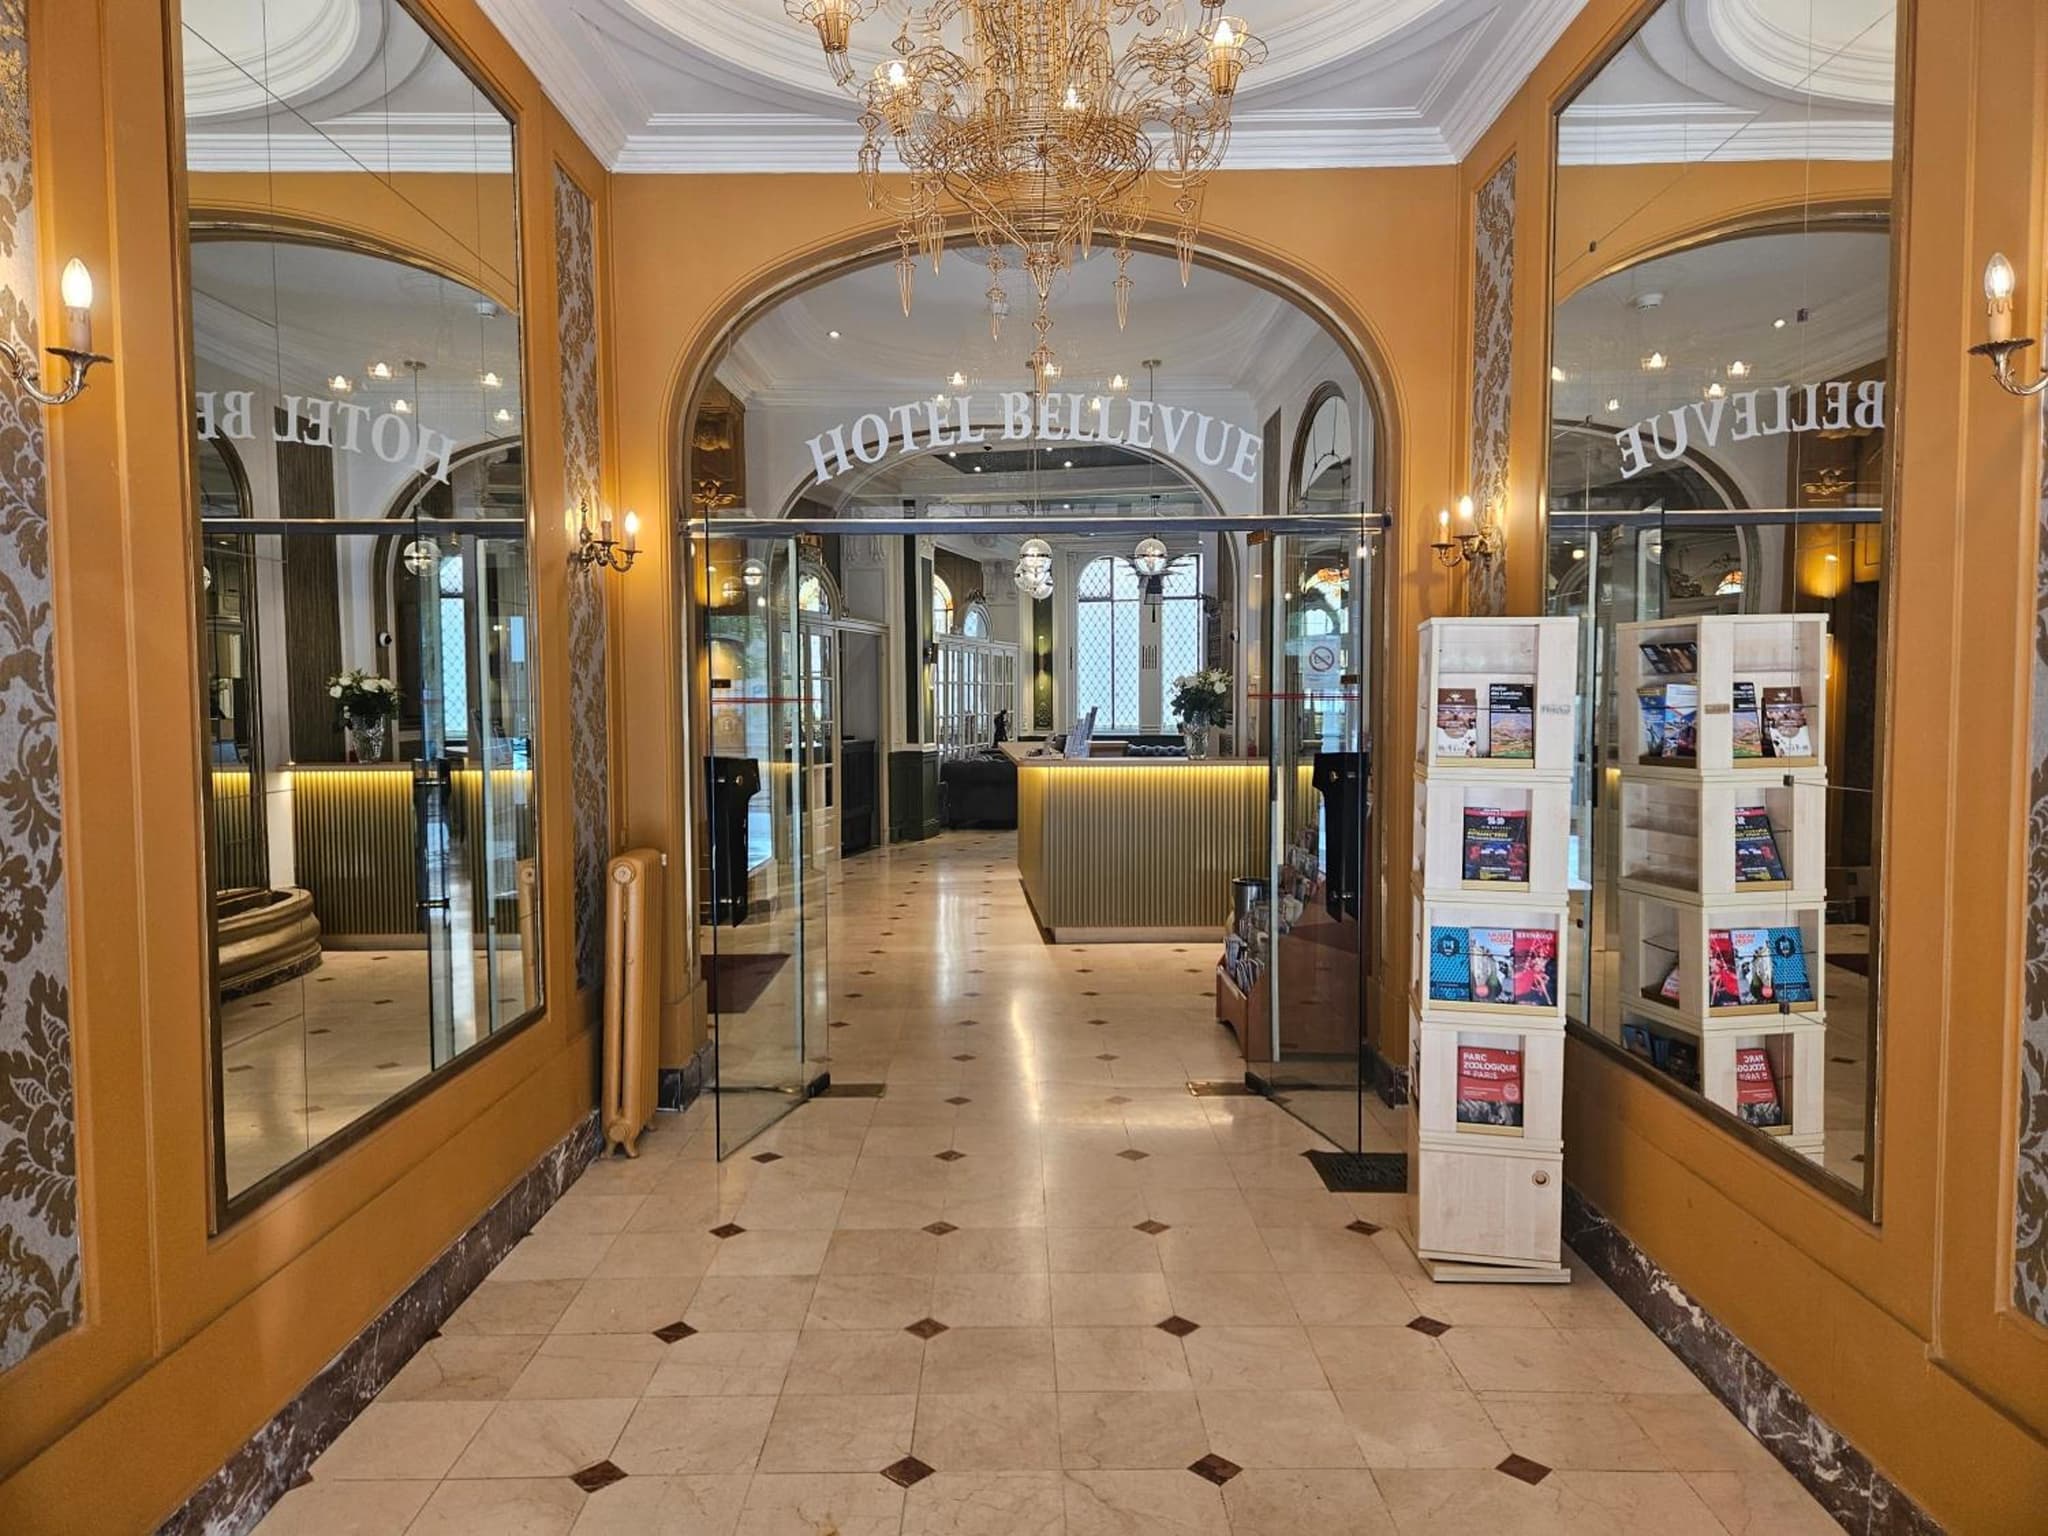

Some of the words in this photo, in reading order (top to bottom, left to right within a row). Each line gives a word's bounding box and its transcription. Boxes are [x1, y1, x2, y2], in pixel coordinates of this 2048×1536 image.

[805, 395, 985, 485] HOTEL
[1000, 392, 1263, 483] BELLEVUE
[1463, 1052, 1487, 1062] PARC
[1463, 1061, 1517, 1073] ZOOLOGIQUE
[1472, 1070, 1498, 1080] PARIS
